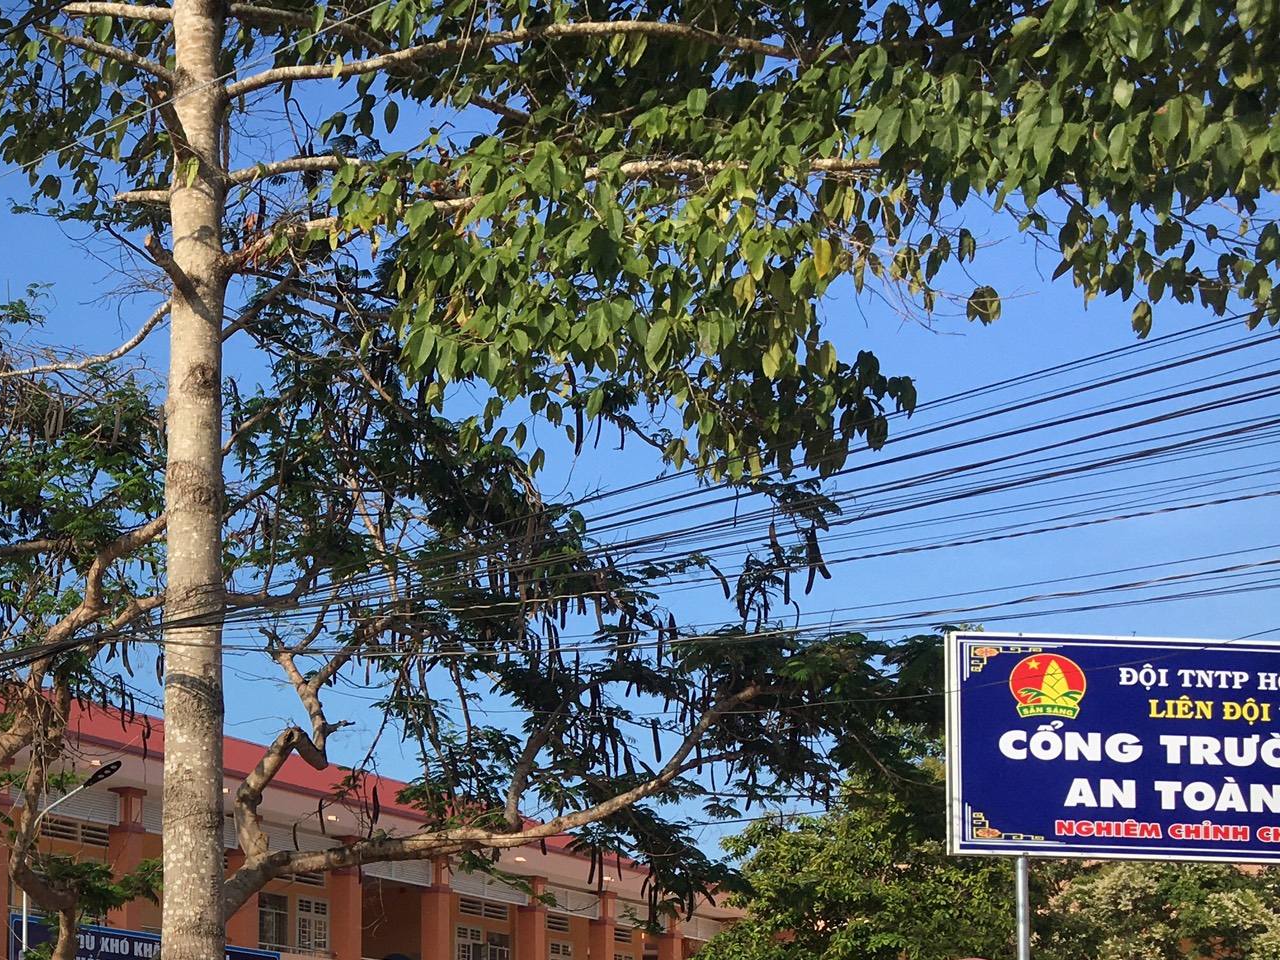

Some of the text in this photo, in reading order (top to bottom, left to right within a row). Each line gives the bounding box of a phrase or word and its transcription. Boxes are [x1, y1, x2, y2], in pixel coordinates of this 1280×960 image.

[1119, 663, 1280, 691] ĐỘI TNTP H
[1149, 695, 1271, 725] LIÊN ĐỘI
[999, 720, 1143, 763] CỔNG
[1064, 777, 1280, 813] AN TOÀN
[1055, 819, 1162, 839] NGHIÊM
[1169, 821, 1250, 841] CHỈNH
[134, 941, 160, 958] KHĂ
